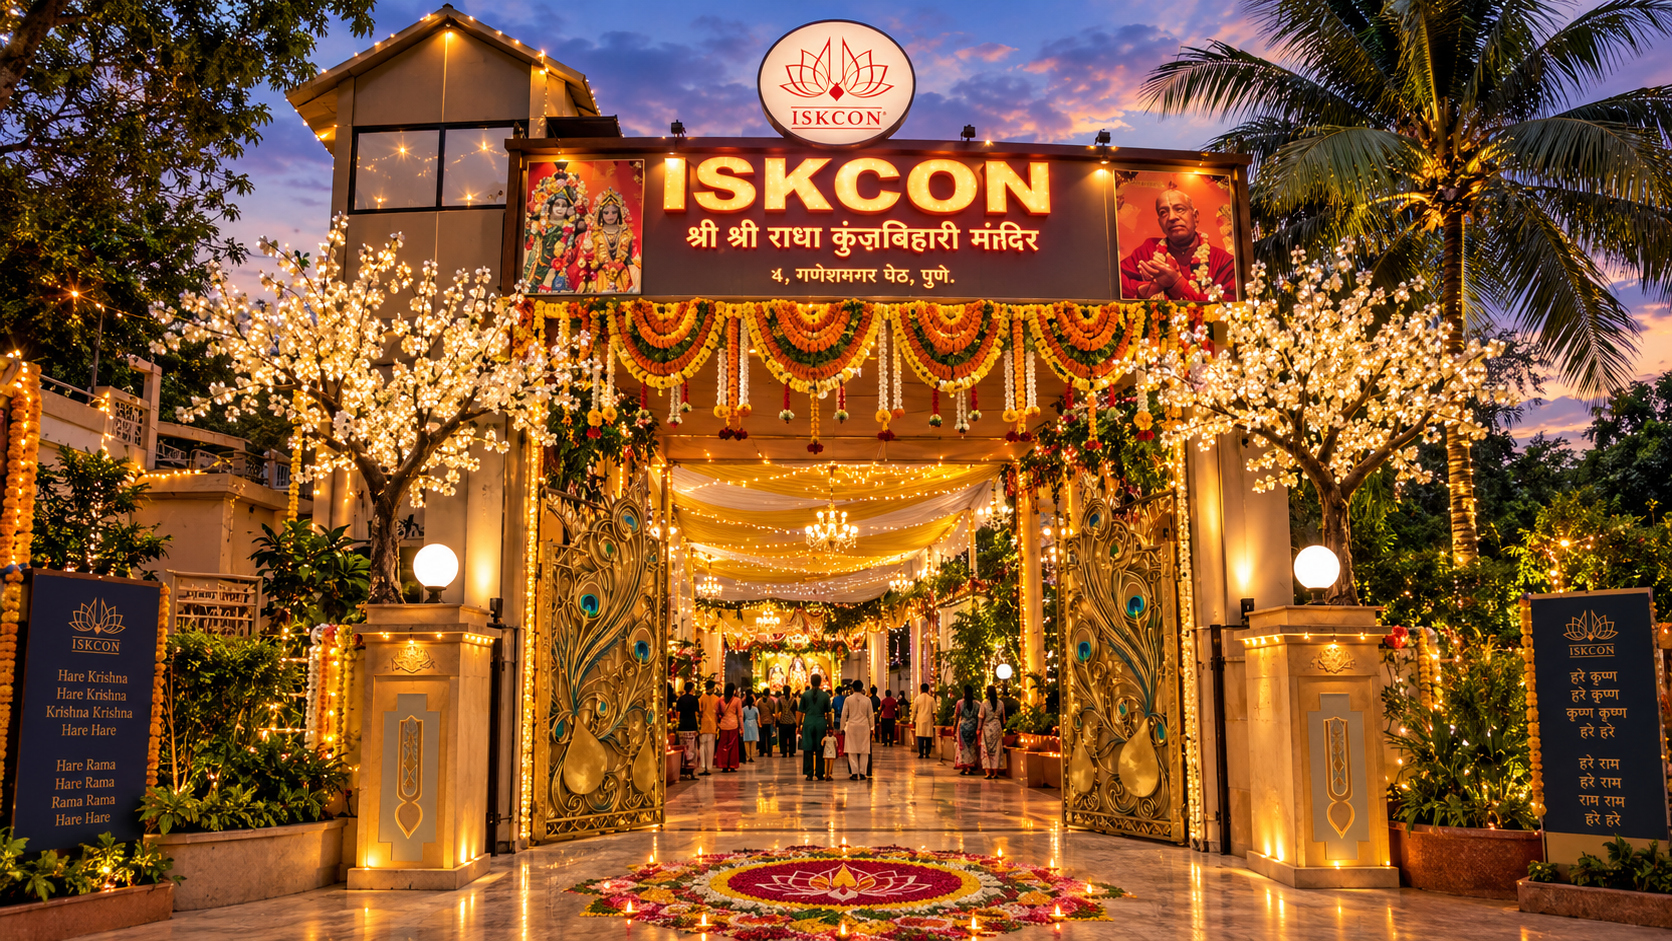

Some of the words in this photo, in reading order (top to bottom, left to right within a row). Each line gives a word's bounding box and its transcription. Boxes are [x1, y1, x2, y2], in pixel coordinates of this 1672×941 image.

[792, 110, 882, 125] ISKCON
[663, 156, 1051, 215] ISKCON
[687, 219, 719, 247] श्री
[727, 219, 759, 247] श्री
[768, 227, 822, 247] राधा
[921, 265, 954, 288] पुणे.
[72, 639, 120, 652] ISKCON
[1569, 645, 1615, 656] ISKCON
[59, 670, 84, 682] Hare
[88, 671, 127, 683] Krishna
[57, 687, 83, 699] Hare
[87, 688, 126, 701] Krishna
[46, 706, 89, 717] Krishna
[93, 706, 132, 718] Krishna
[62, 724, 88, 736] Hare
[91, 724, 116, 735] Hare
[57, 760, 83, 771] Hare
[87, 759, 115, 770] Rama
[56, 778, 82, 790] Hare
[86, 777, 114, 788] Rama
[52, 796, 82, 808] Rama
[87, 795, 115, 805] Rama
[56, 814, 82, 826] Hare
[86, 812, 110, 823] Hare
